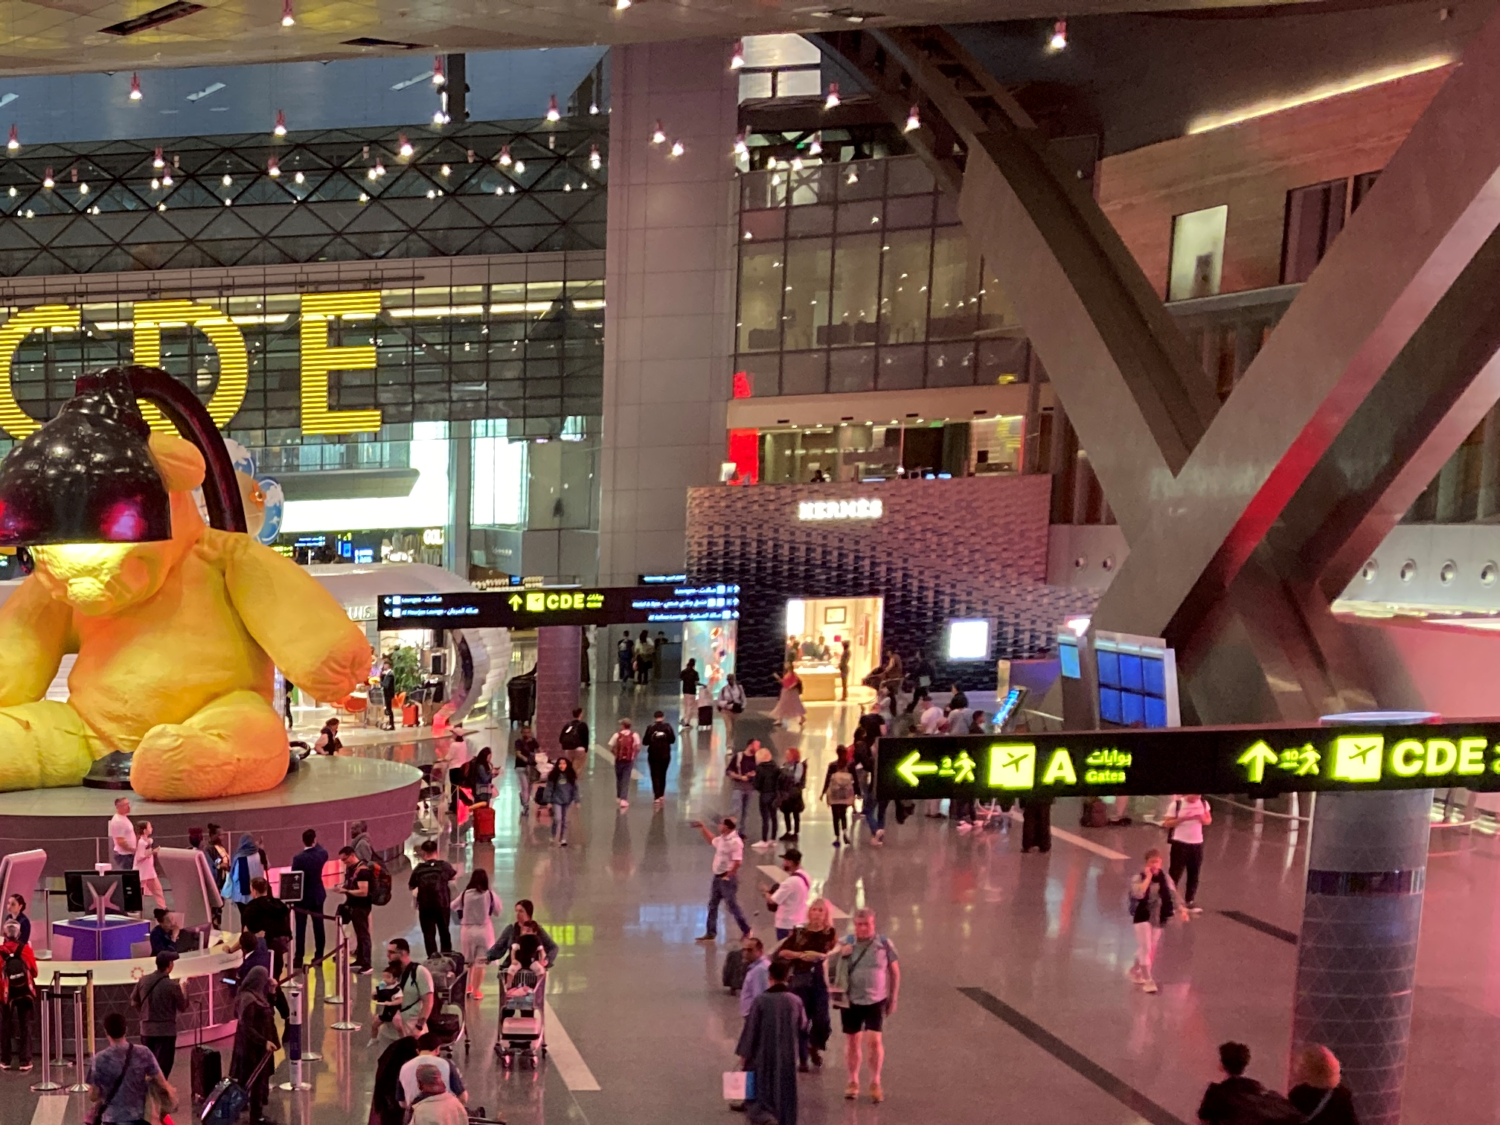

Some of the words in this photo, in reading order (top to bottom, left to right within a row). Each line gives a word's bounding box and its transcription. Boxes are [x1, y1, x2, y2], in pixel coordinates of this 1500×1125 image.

[546, 594, 584, 609] CDE
[1043, 750, 1076, 785] A
[1086, 750, 1132, 771] بوابات
[1390, 738, 1488, 777] CDE
[1086, 771, 1126, 784] Gates
